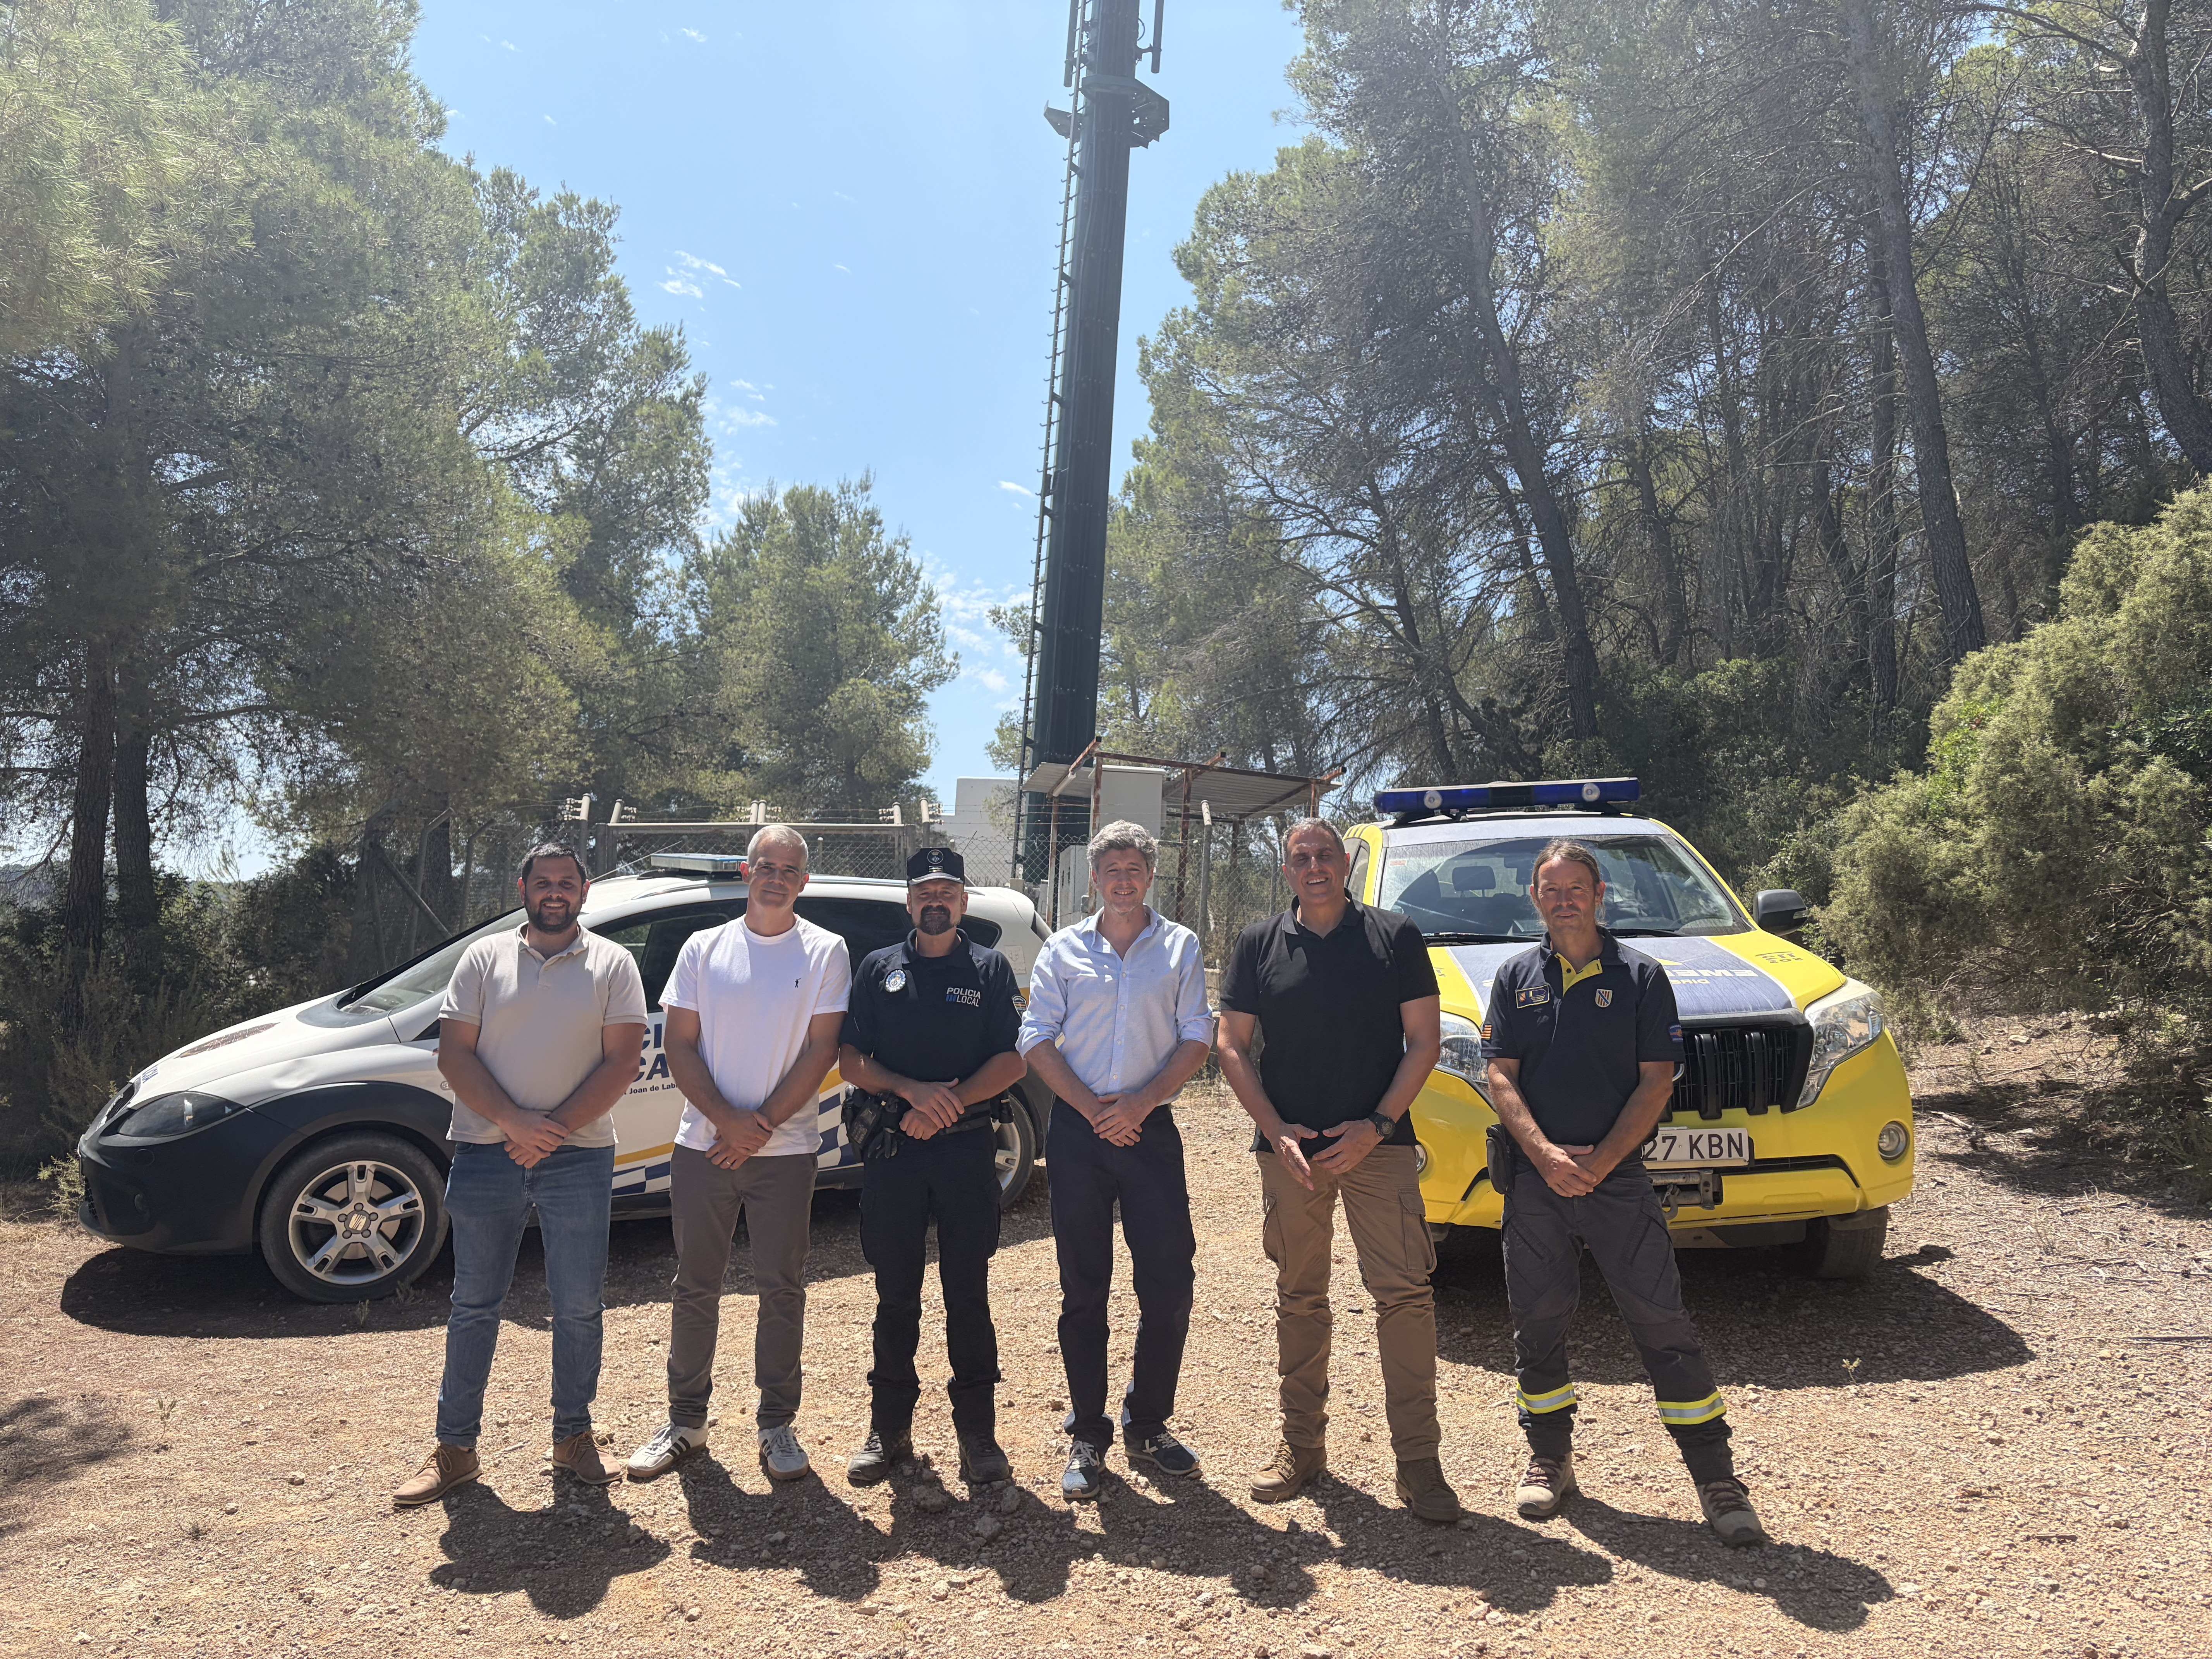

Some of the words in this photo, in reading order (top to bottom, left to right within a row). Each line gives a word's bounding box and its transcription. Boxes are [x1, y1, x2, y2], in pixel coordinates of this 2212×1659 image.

[946, 987, 981, 999] POLICIA
[957, 995, 979, 1007] LOCAL
[1689, 1133, 1743, 1159] KBN
